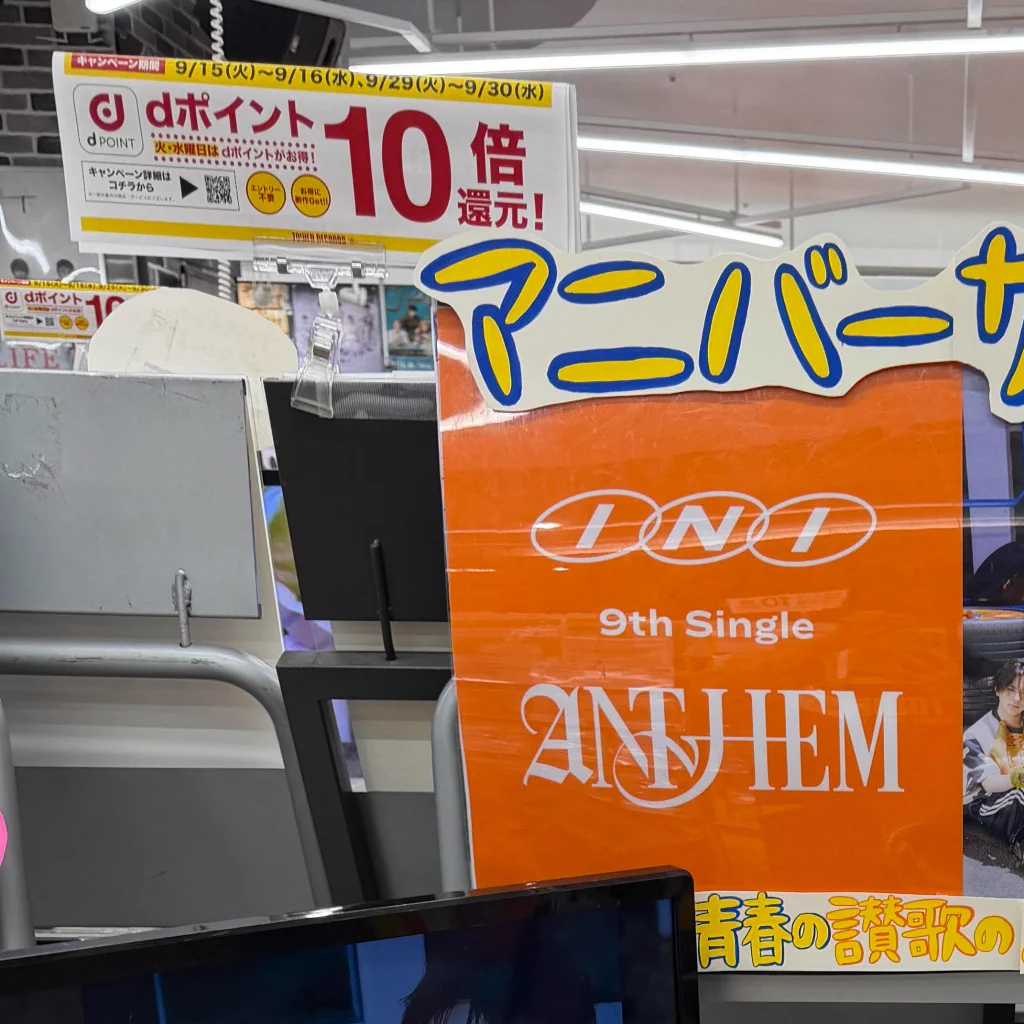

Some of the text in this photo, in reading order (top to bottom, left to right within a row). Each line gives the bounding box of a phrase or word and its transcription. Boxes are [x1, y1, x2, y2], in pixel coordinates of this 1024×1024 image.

[146, 92, 314, 138] dポイント
[87, 133, 135, 149] d POINT
[470, 122, 526, 186] 倍
[88, 168, 171, 182] キャンペーン詳細は
[324, 106, 451, 223] 10
[109, 181, 154, 193] コチラから
[457, 188, 544, 231] 還元!
[24, 291, 82, 305] dポイント
[599, 608, 814, 645] 9th Single
[520, 684, 904, 808] ANTHEM
